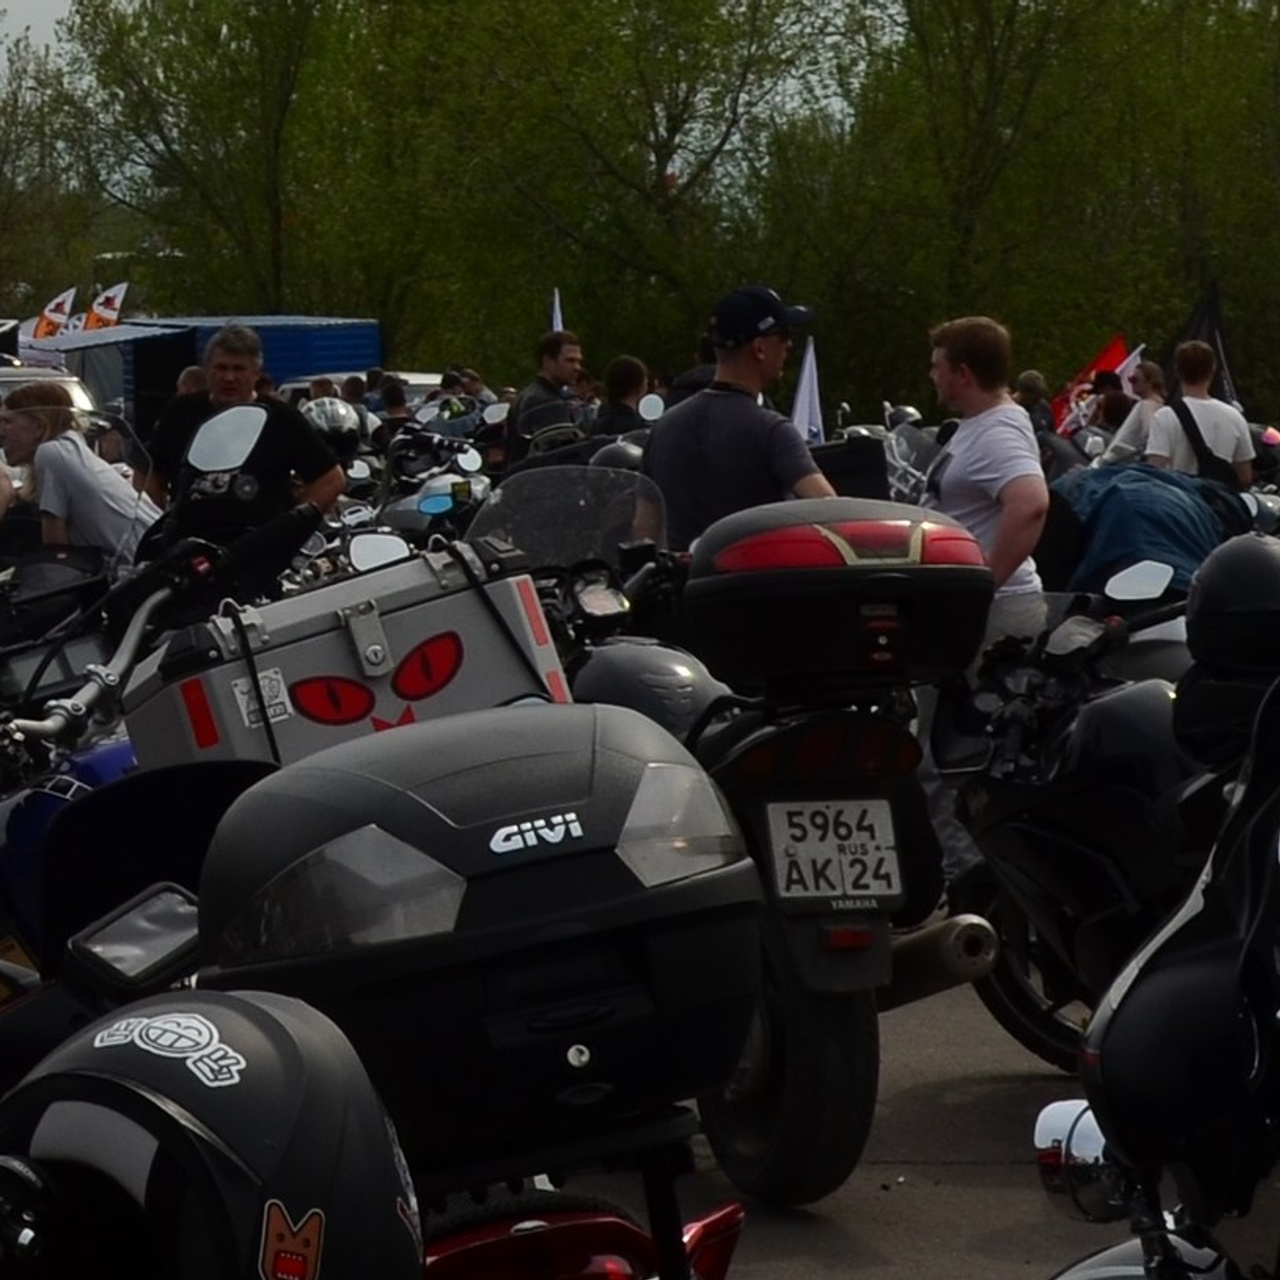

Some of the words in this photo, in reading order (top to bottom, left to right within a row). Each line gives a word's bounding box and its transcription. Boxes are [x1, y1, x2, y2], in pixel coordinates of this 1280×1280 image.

[489, 812, 584, 854] GIVI
[786, 808, 876, 843] 5964
[837, 844, 869, 856] RUS
[785, 858, 836, 892] AK
[849, 857, 892, 890] 24
[830, 897, 879, 911] YAMAHA
